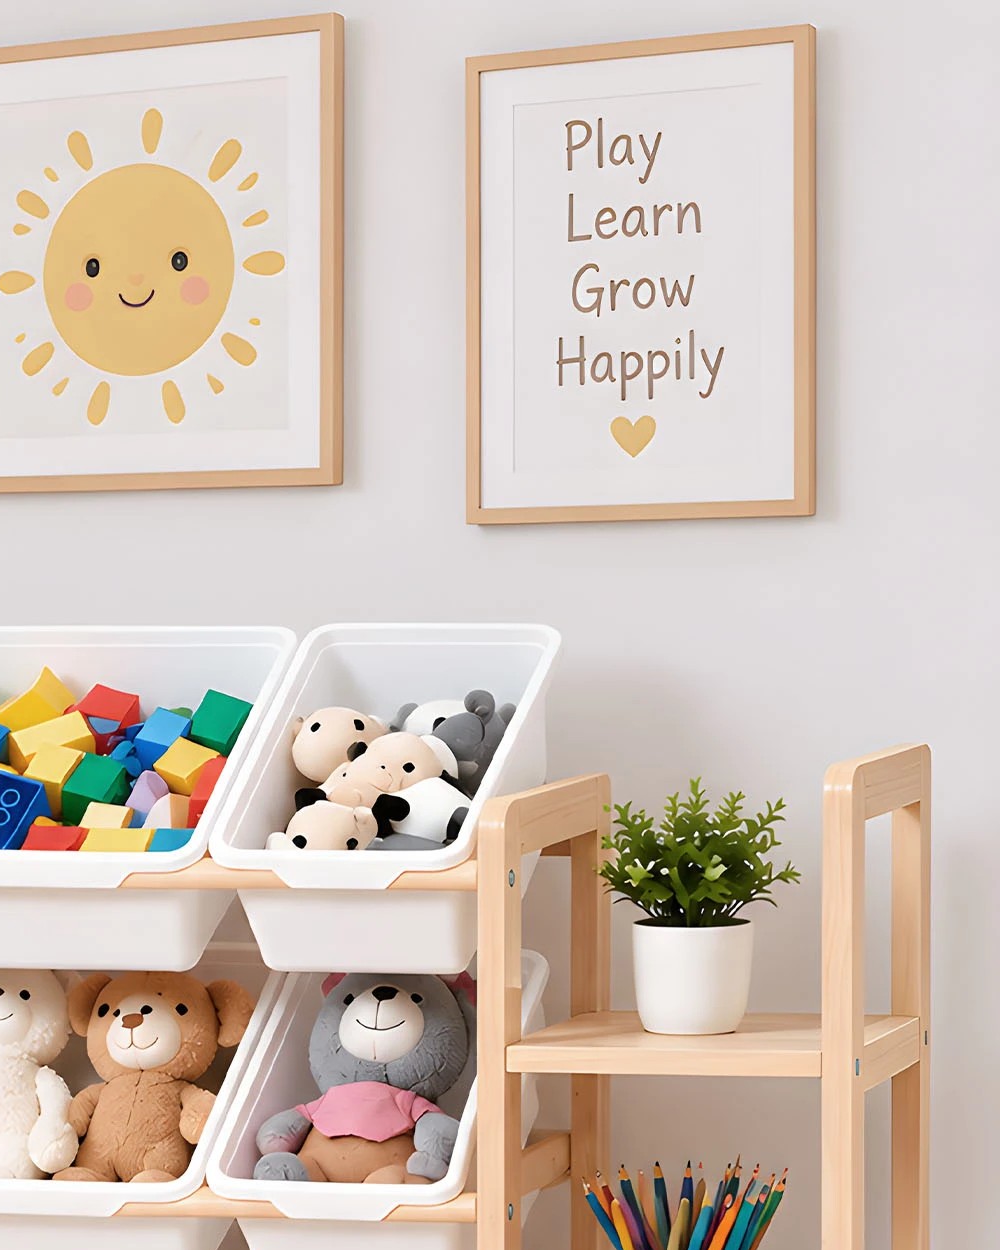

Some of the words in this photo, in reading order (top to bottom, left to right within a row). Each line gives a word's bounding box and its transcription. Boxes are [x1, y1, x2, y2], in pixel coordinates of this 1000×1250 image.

[565, 117, 663, 185] Play
[567, 193, 702, 243] Learn
[571, 263, 695, 318] Grow
[556, 329, 725, 402] Happily
